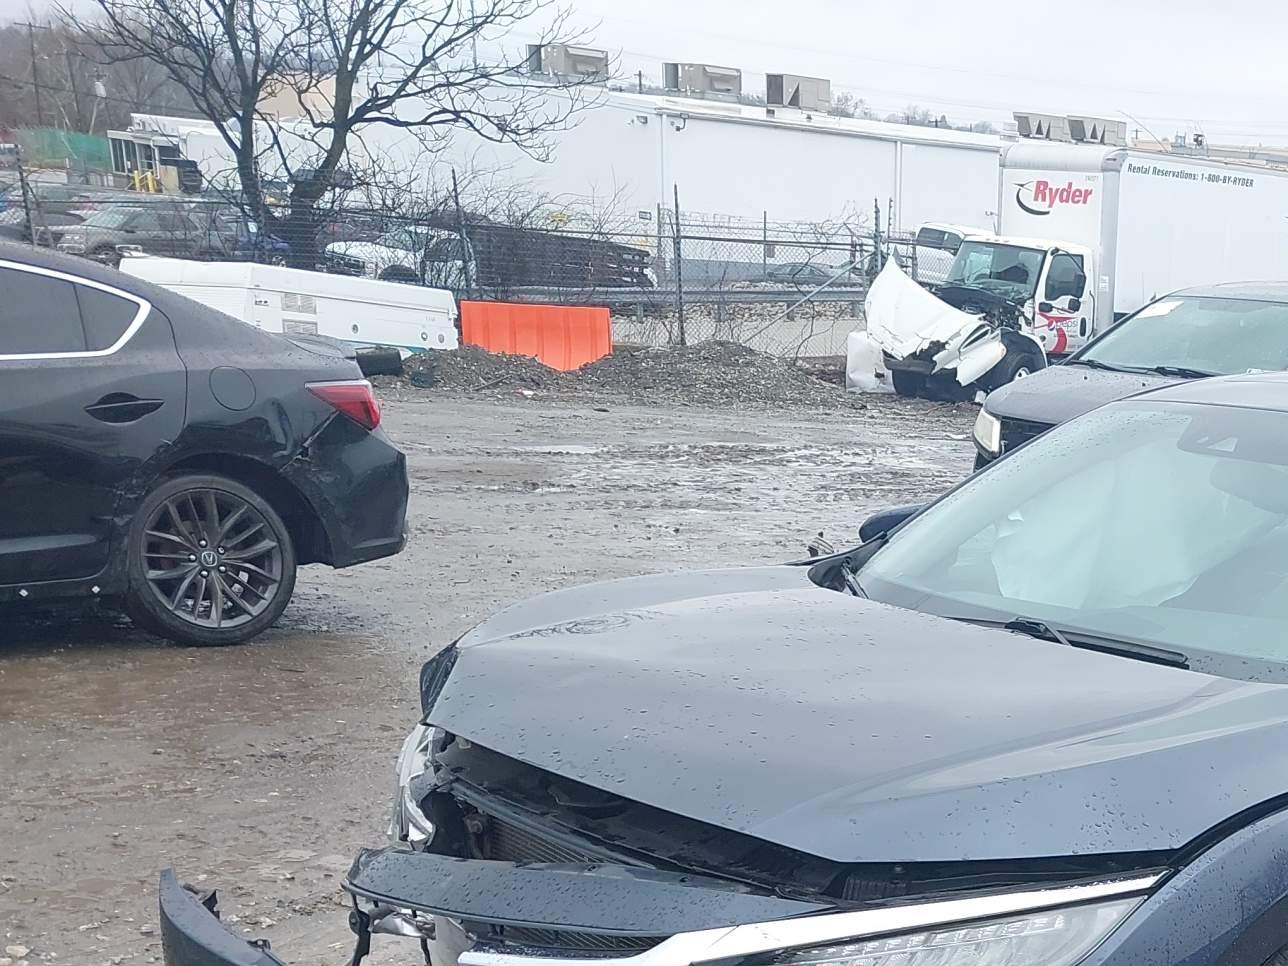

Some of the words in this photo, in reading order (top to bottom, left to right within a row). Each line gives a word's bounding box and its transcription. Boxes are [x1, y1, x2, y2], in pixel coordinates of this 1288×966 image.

[1128, 163, 1150, 175] Rental
[1152, 166, 1199, 181] Reservations:
[1201, 173, 1254, 188] 1-800-BY-RYDER
[1033, 180, 1093, 209] Ryder
